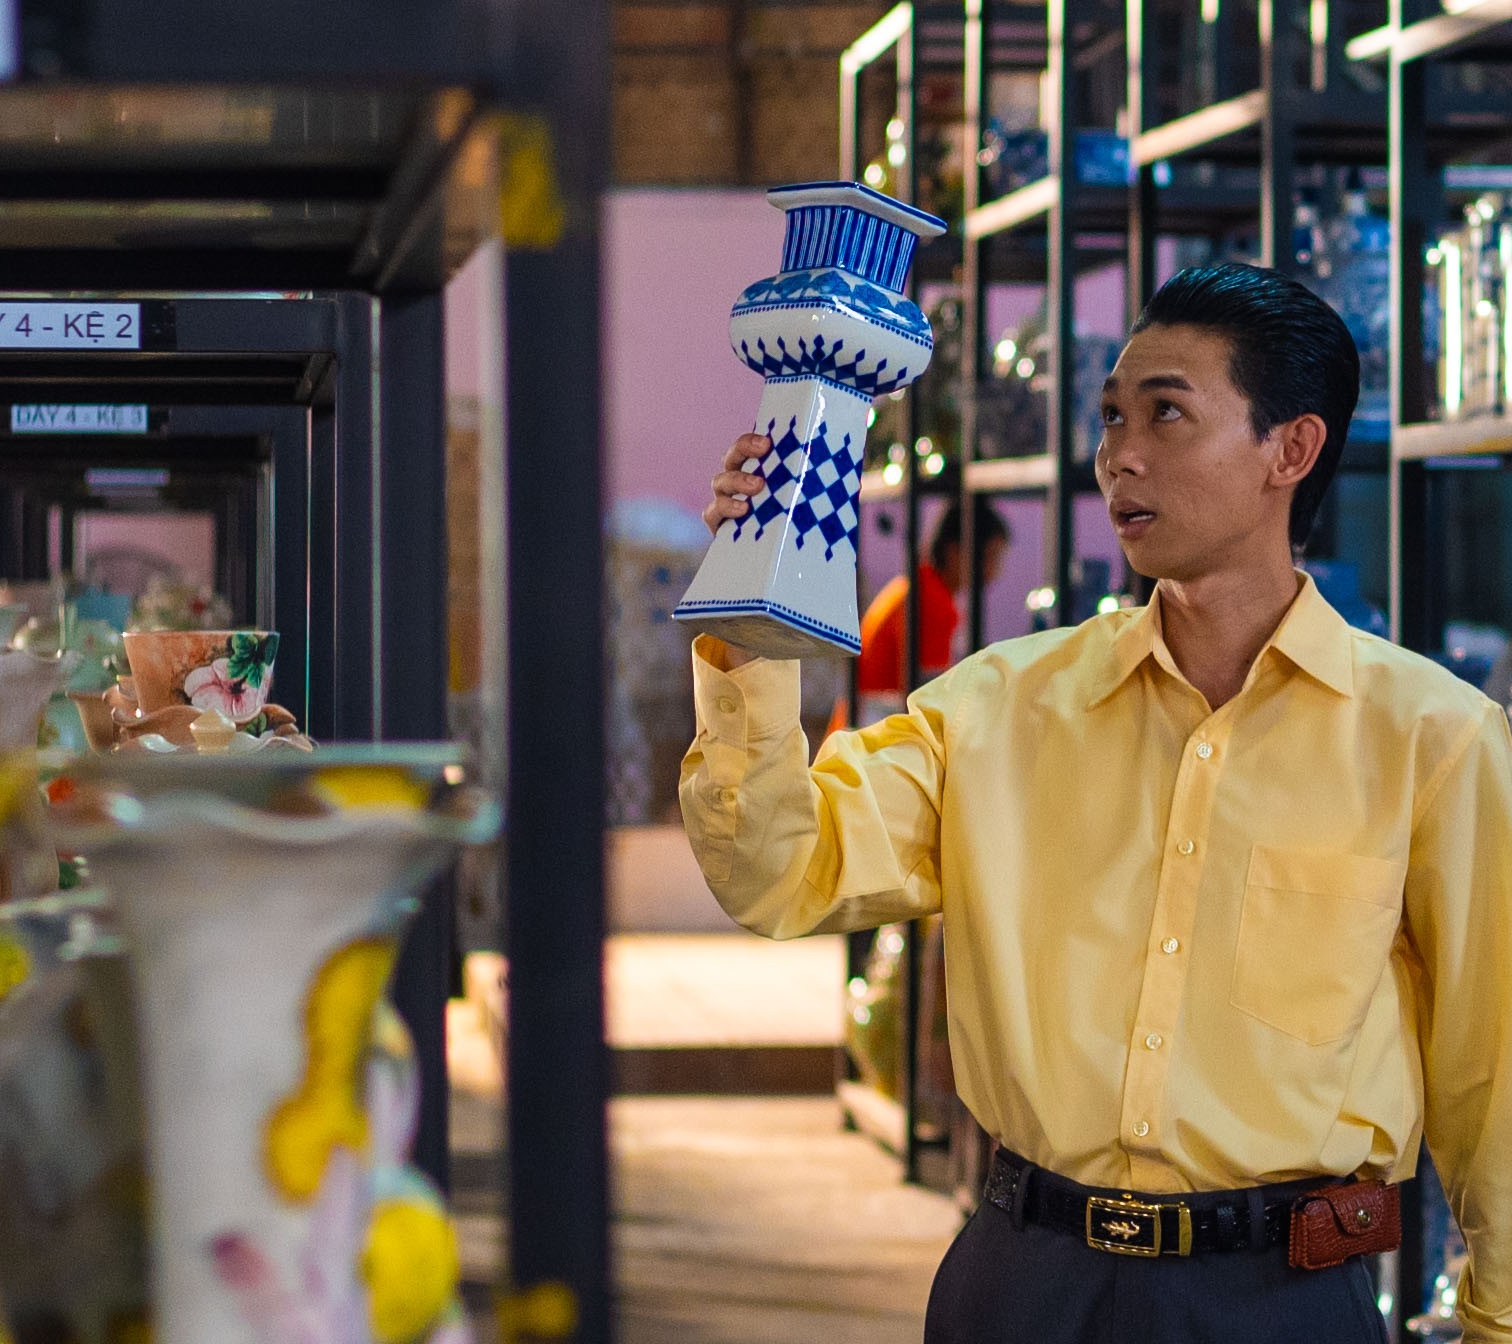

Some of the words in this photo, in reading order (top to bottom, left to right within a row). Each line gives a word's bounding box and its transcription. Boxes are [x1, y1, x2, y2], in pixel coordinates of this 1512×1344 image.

[15, 313, 32, 338] 4
[64, 311, 105, 343] KỆ
[116, 314, 133, 339] 2
[66, 406, 77, 425] 4
